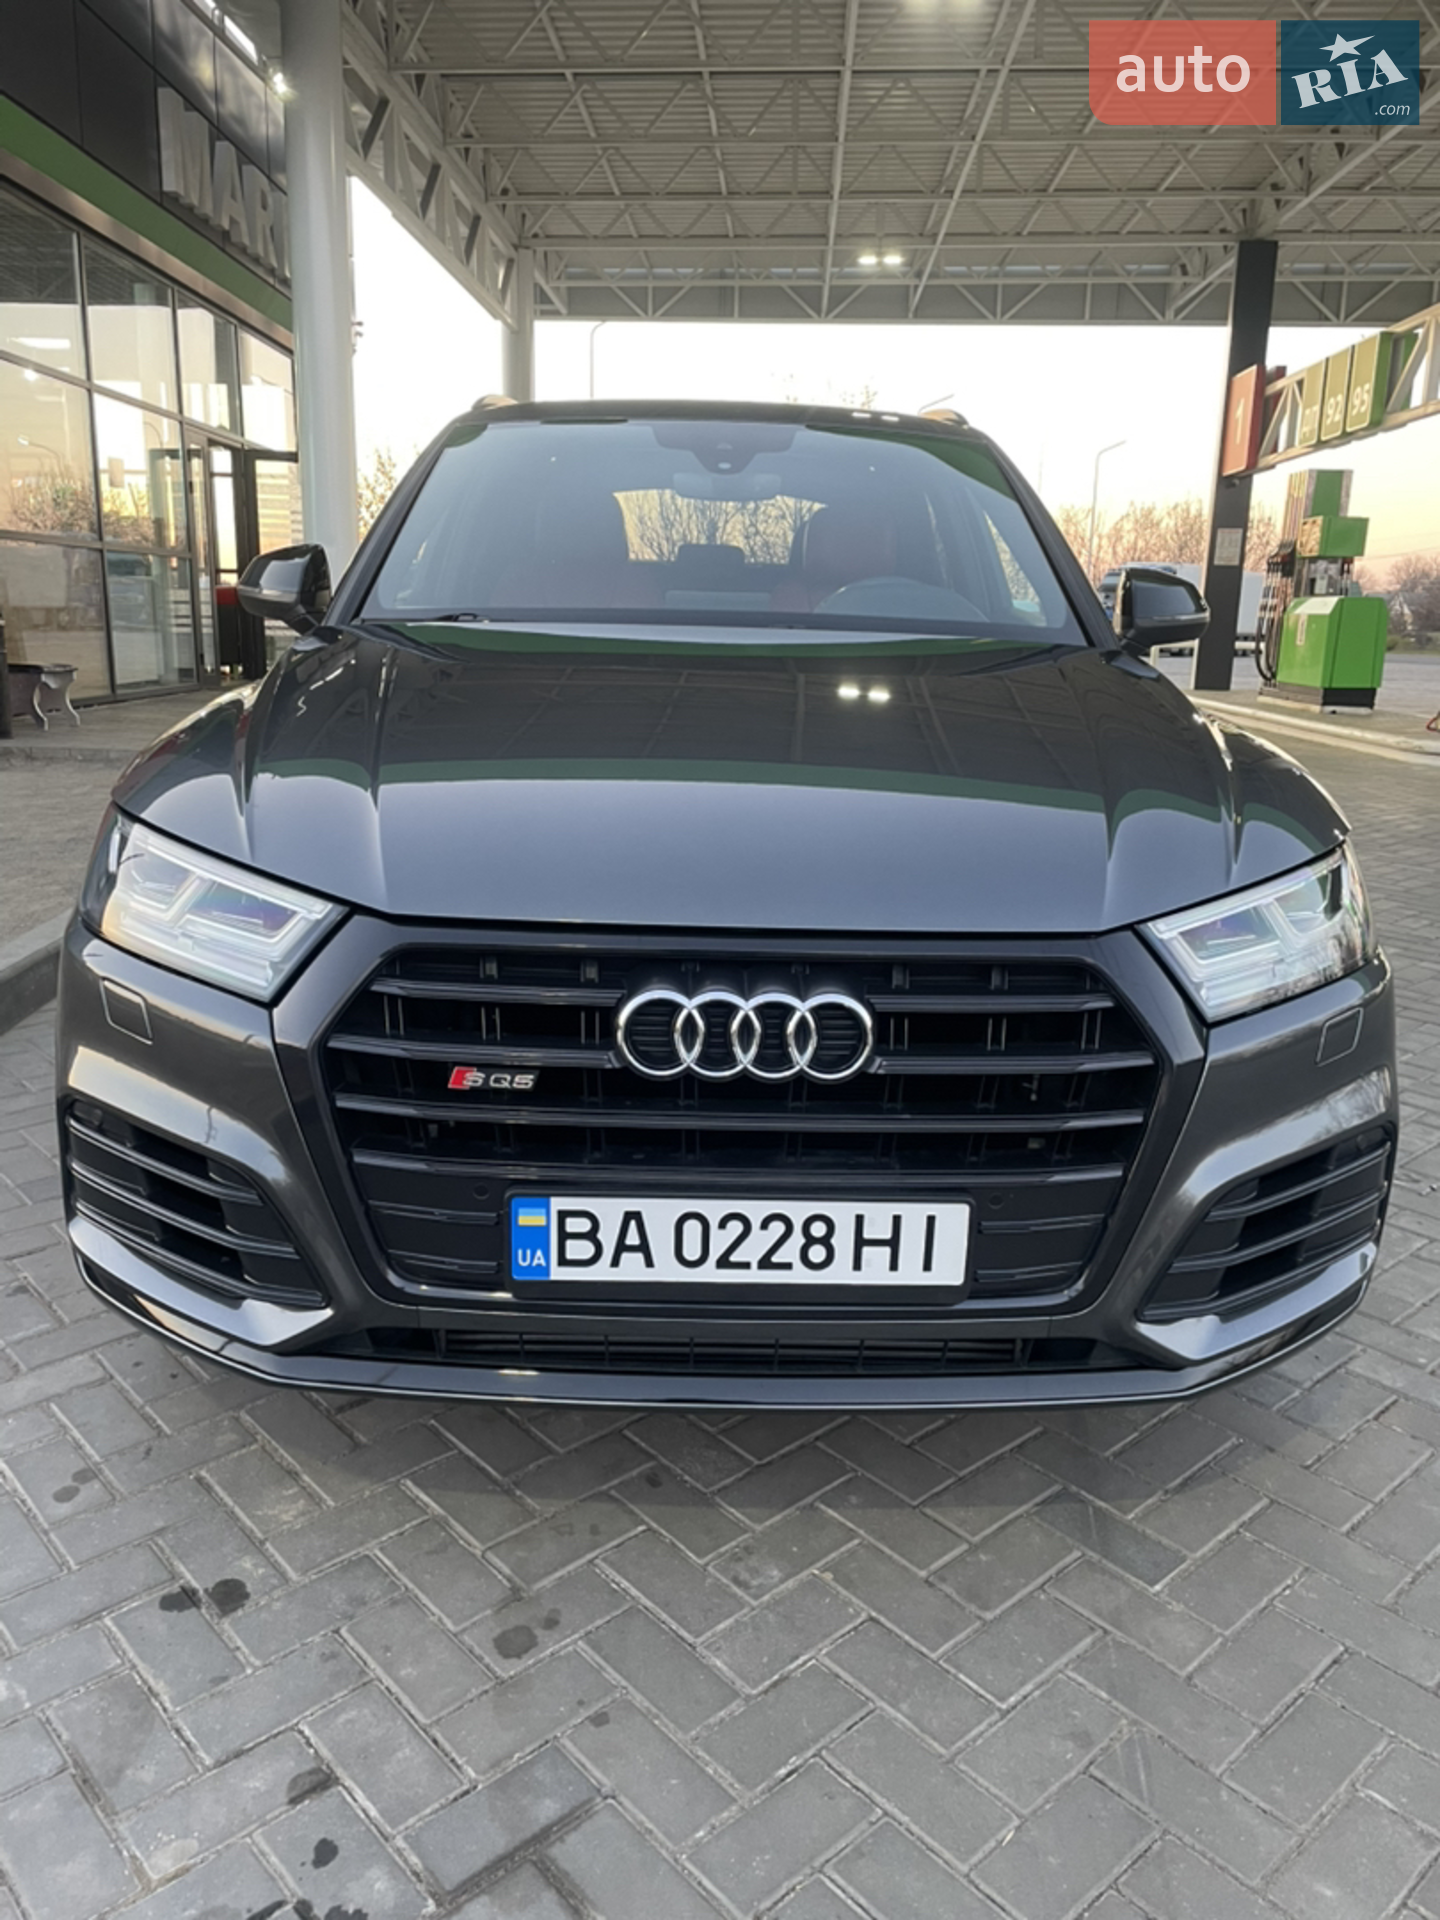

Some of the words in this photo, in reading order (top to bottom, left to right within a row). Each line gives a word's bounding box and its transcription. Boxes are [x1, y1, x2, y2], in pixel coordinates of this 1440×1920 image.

[1326, 393, 1343, 426] 92
[1351, 382, 1370, 417] 95
[1234, 396, 1245, 446] 1
[463, 1071, 535, 1090] SQ5
[517, 1248, 546, 1267] UA
[556, 1208, 656, 1269] BA
[673, 1210, 836, 1272] 0228
[852, 1213, 937, 1273] HI
